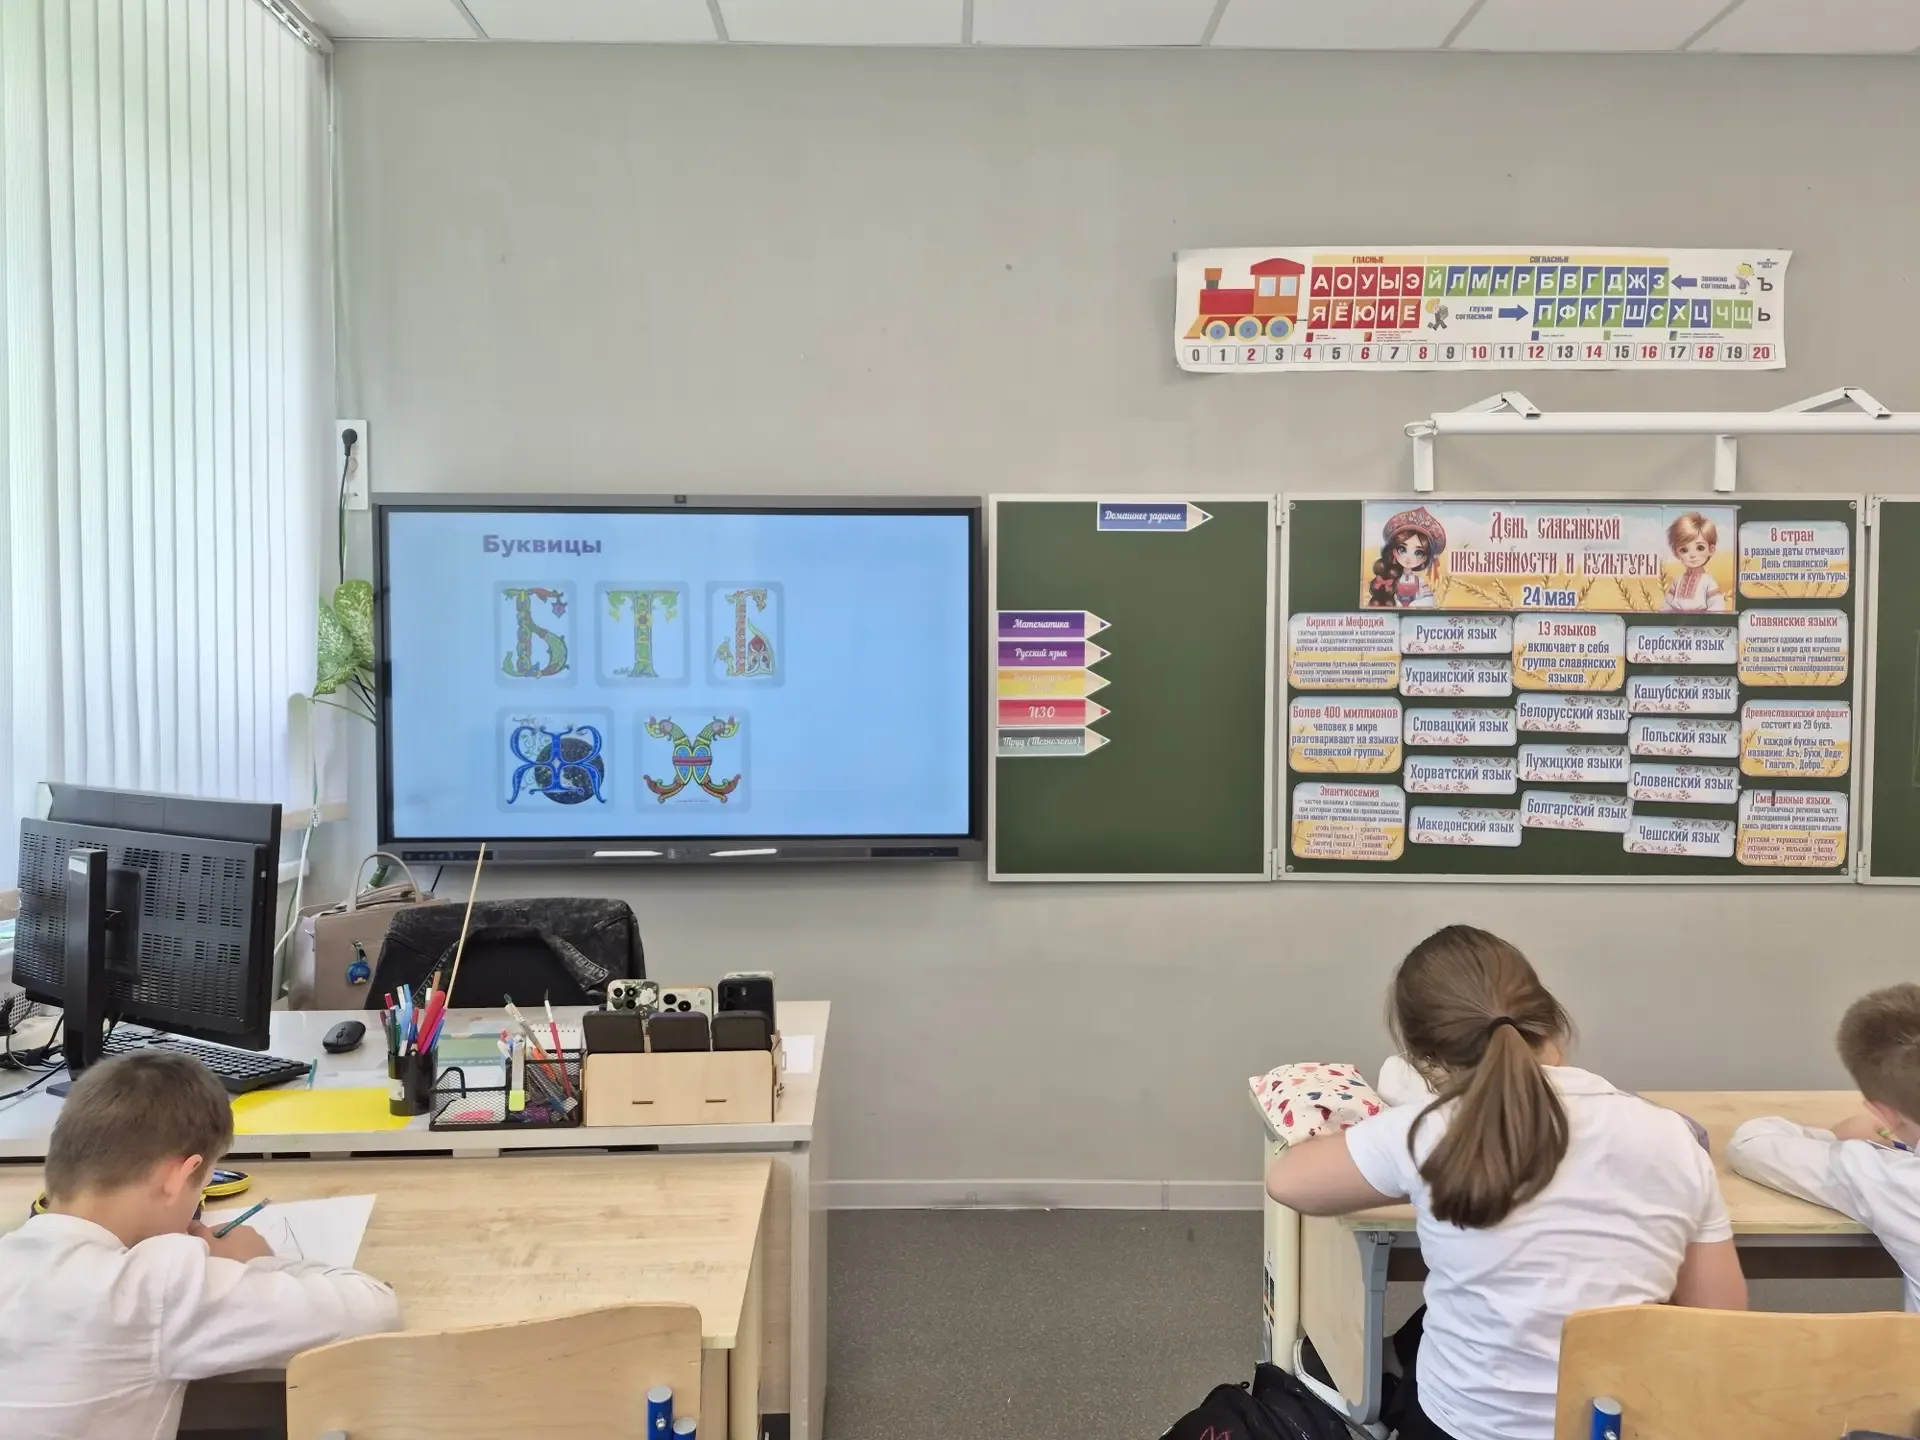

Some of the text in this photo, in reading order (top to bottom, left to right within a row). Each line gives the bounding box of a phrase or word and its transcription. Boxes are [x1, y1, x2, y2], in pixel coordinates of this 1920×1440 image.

[1313, 273, 1420, 290] А О У Ы Э
[1428, 269, 1665, 292] Й Л М Н Р Б В Г Д Ж З
[1757, 277, 1773, 291] Ъ
[1312, 302, 1416, 322] Я Ё Ю И Е
[1538, 304, 1752, 324] П Ф К Т Ш С Х Ц Ч Щ
[1758, 307, 1771, 322] Ь
[1192, 345, 1770, 361] 0 1 2 3 4 5 6 7 8 9 10 11 12 13 14 15 16 17 18 19 20
[1104, 510, 1181, 524] Домашнее задание
[1771, 527, 1814, 545] 8 стран
[482, 534, 602, 558] Буквицы
[1744, 547, 1844, 558] в разные даты отмечают
[1761, 558, 1828, 570] День славянской
[1741, 572, 1848, 583] письменности и культуры.
[1523, 586, 1576, 606] 24 мая
[1012, 619, 1070, 629] Математика
[1345, 616, 1384, 629] Мефодий
[1750, 614, 1838, 627] Славянские языки
[1416, 625, 1497, 643] Русский язык
[1538, 621, 1596, 636] 13 языков
[1528, 641, 1609, 653] включает в себя
[1638, 635, 1724, 654] Сербский язык
[1014, 648, 1068, 661] Русский язык
[1522, 657, 1616, 670] группа славянских
[1405, 667, 1474, 686] Украинский
[1477, 671, 1508, 683] язык
[1548, 673, 1586, 683] языков.
[1634, 684, 1731, 703] Кашубский язык
[1029, 706, 1055, 718] ИЗО
[1293, 706, 1398, 718] Более 400 миллионов
[1520, 702, 1625, 721] Белорусский язык
[1313, 723, 1377, 734] человек в мире
[1413, 716, 1508, 734] Словацкий язык
[1761, 720, 1832, 731] состоит из 29 букв.
[1292, 735, 1399, 746] разговаривают на языках
[1642, 727, 1727, 744] Польский язык
[1757, 736, 1835, 748] У каждой буквы есть
[1304, 747, 1351, 757] славянской
[1526, 753, 1623, 771] Лужицкие языки
[1410, 764, 1511, 782] Хорватский язык
[1634, 771, 1733, 790] Словенский язык
[1527, 798, 1628, 819] Болгарский язык
[1417, 816, 1514, 833] Македонский язык
[1640, 826, 1720, 843] Чешский язык
